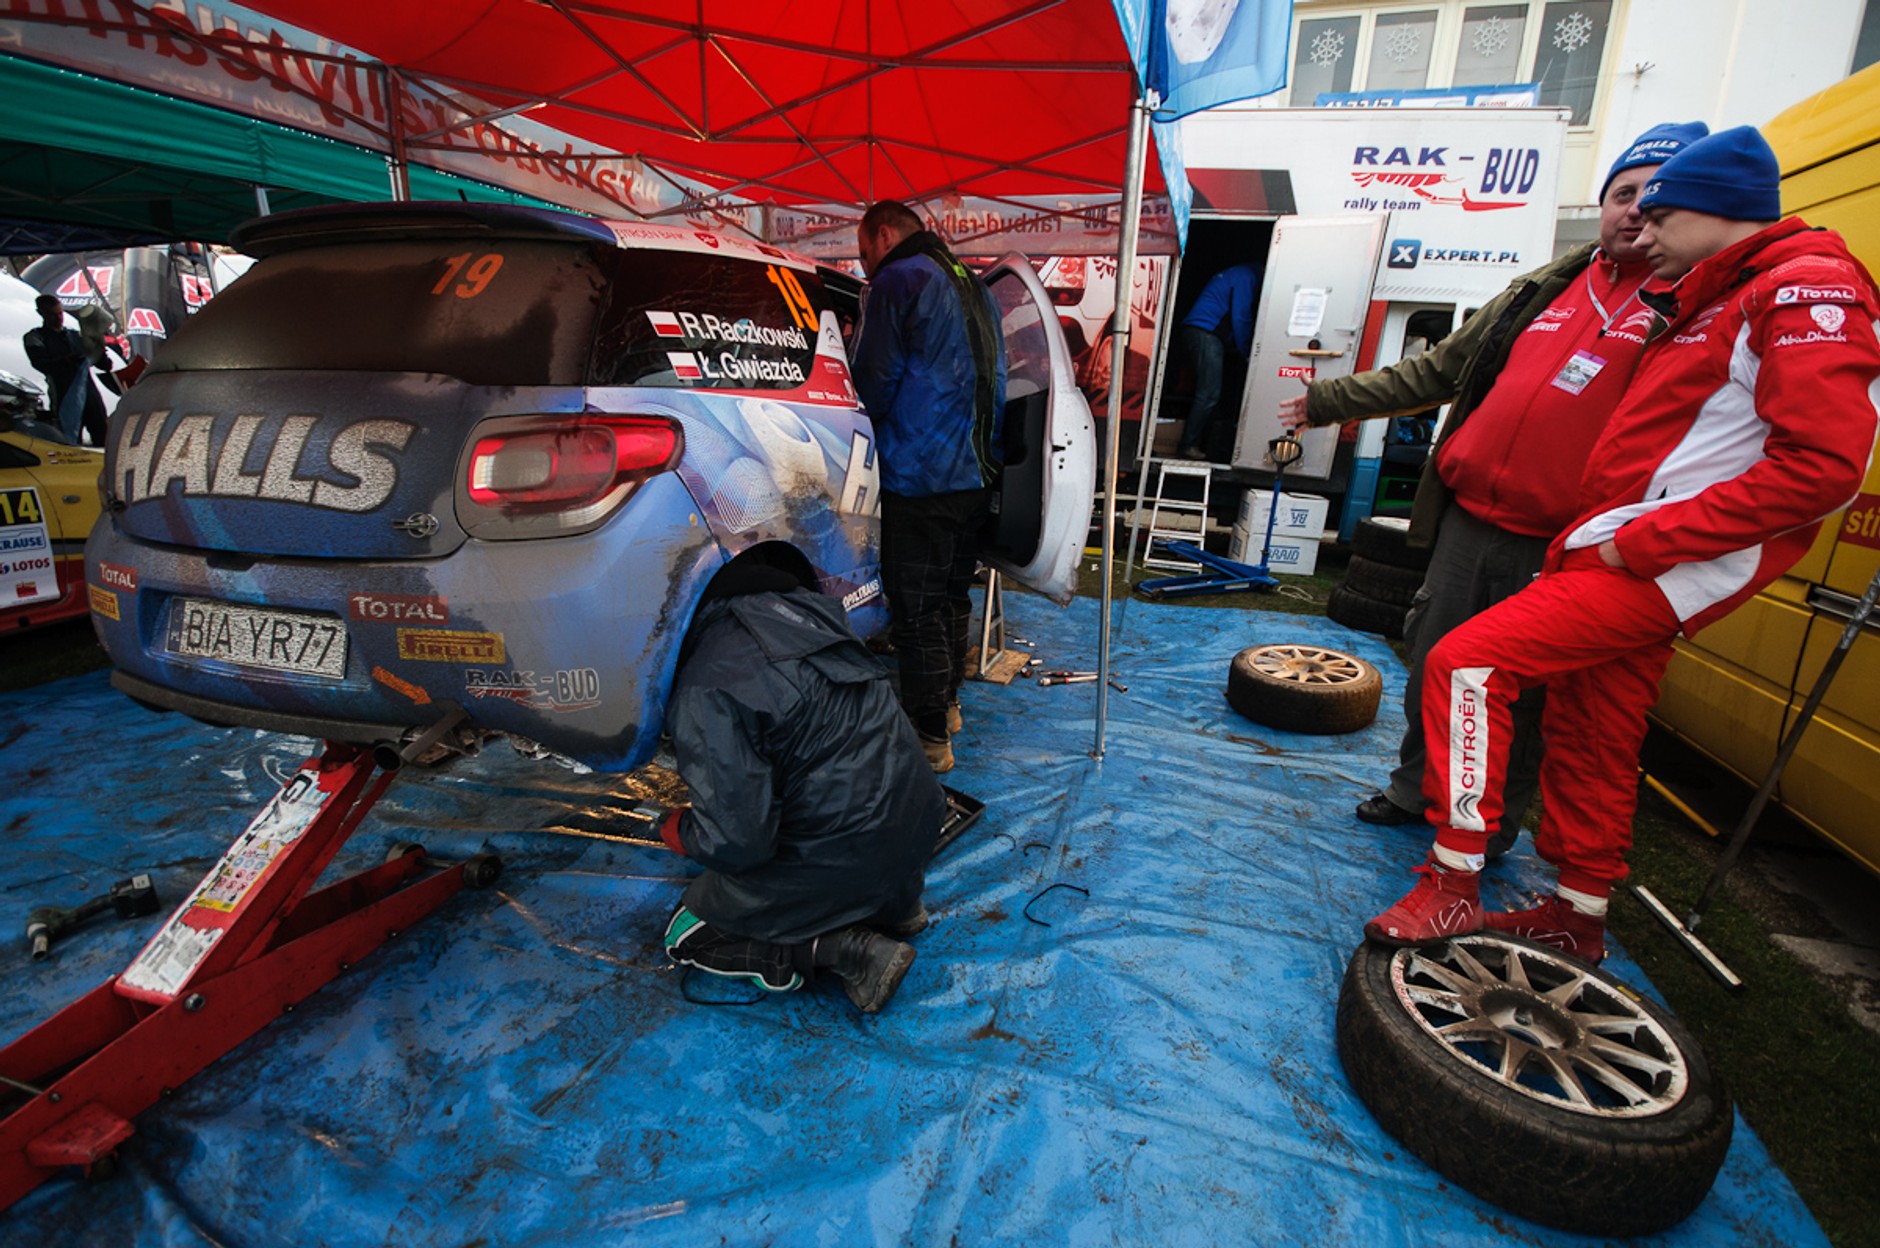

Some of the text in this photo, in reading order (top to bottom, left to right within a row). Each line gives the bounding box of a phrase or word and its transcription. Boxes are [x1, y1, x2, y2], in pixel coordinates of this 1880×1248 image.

[1353, 146, 1449, 166] RAK
[1479, 148, 1540, 195] BUD
[1344, 198, 1421, 212] rally team
[1424, 249, 1520, 263] EXPERT.PL
[431, 252, 503, 299] 19
[766, 264, 819, 333] 19
[1800, 289, 1853, 299] TOTAL
[678, 311, 808, 350] R.Raczkowski
[114, 409, 418, 512] HALLS
[12, 557, 50, 572] LOTOS
[100, 563, 136, 588] TOTAL
[352, 596, 445, 621] TOTAL
[186, 610, 338, 668] BIA YR77
[404, 633, 496, 658] PIRELLI
[466, 669, 536, 688] RAK
[556, 667, 601, 703] BUD
